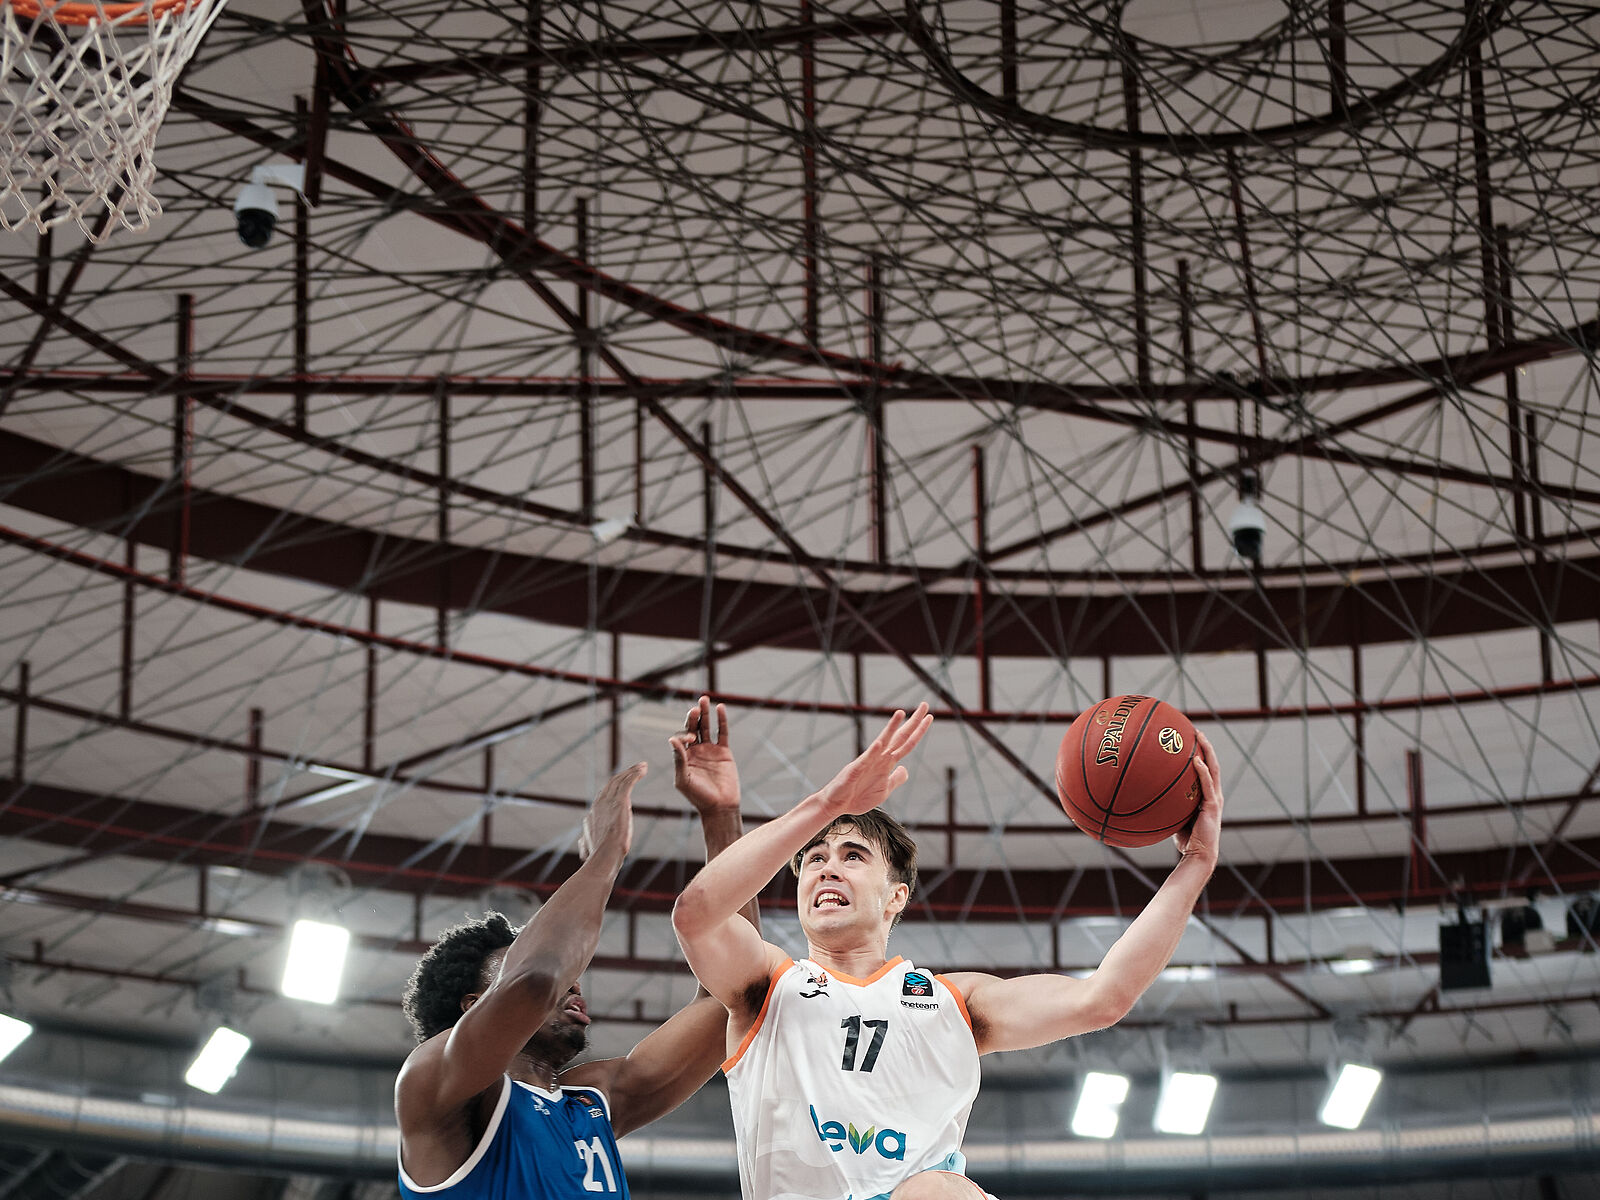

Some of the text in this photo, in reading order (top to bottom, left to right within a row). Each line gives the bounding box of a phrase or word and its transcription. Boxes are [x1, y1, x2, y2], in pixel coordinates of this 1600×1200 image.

[1096, 695, 1150, 768] SPALDIN
[840, 1014, 888, 1073] 17
[574, 1136, 617, 1192] 21
